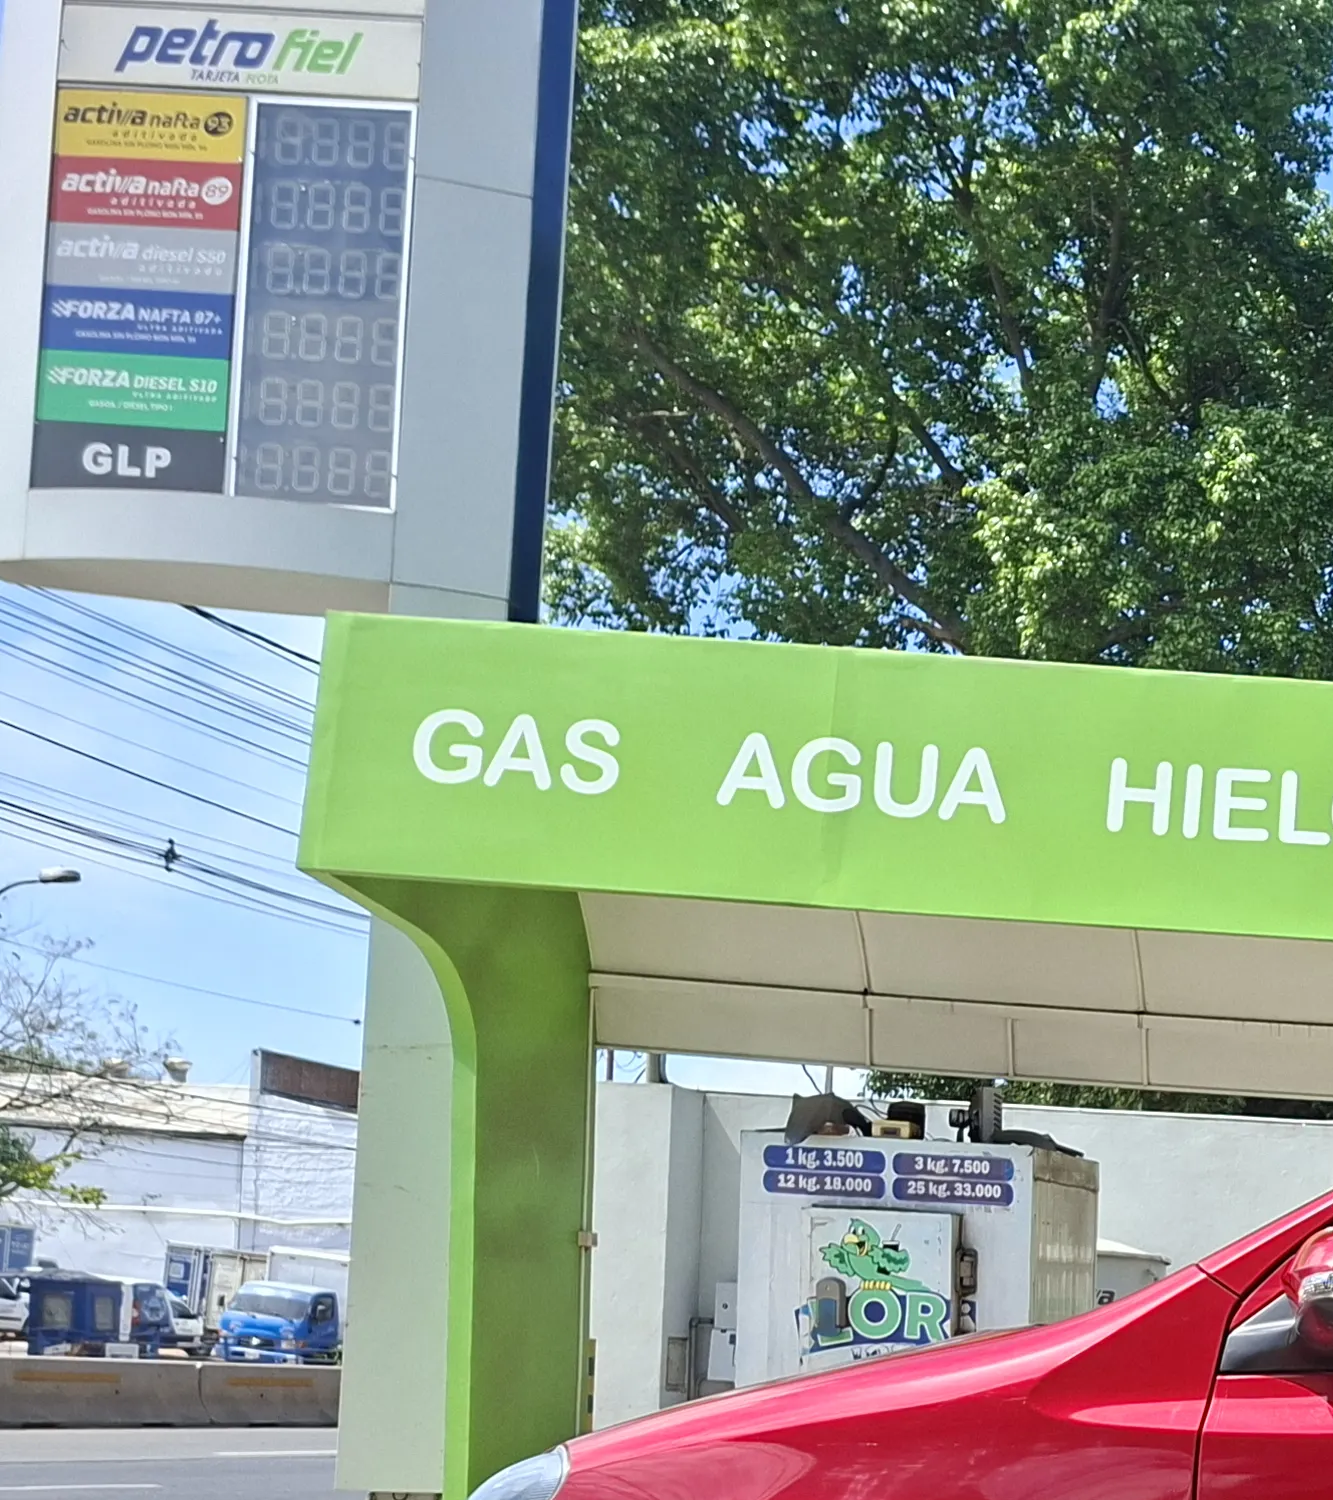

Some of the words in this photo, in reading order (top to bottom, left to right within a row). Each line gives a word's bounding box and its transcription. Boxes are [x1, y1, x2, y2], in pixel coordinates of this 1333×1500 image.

[114, 18, 276, 73] petro
[272, 28, 364, 75] fiel
[190, 68, 240, 83] TARJETA
[149, 111, 200, 130] nafta
[148, 177, 200, 198] nafta
[142, 244, 195, 264] diesel
[64, 300, 136, 321] FORZA
[138, 307, 191, 324] NAFTA
[59, 366, 131, 388] FORZA
[133, 374, 187, 393] DIESEL
[189, 378, 218, 395] S10
[82, 441, 172, 479] GLP
[412, 708, 620, 795] GAS
[715, 732, 1007, 825] AGUA
[785, 1147, 795, 1165] 1
[798, 1148, 820, 1169] kg.
[823, 1150, 864, 1168] 3.500
[914, 1156, 924, 1171] 3
[927, 1157, 949, 1174] kg.
[952, 1159, 990, 1174] 7.500
[777, 1173, 796, 1188] 12
[798, 1174, 820, 1192] kg.
[824, 1176, 872, 1192] 18.000
[907, 1180, 926, 1195] 25
[928, 1182, 951, 1198] kg.
[954, 1183, 1002, 1199] 33.000
